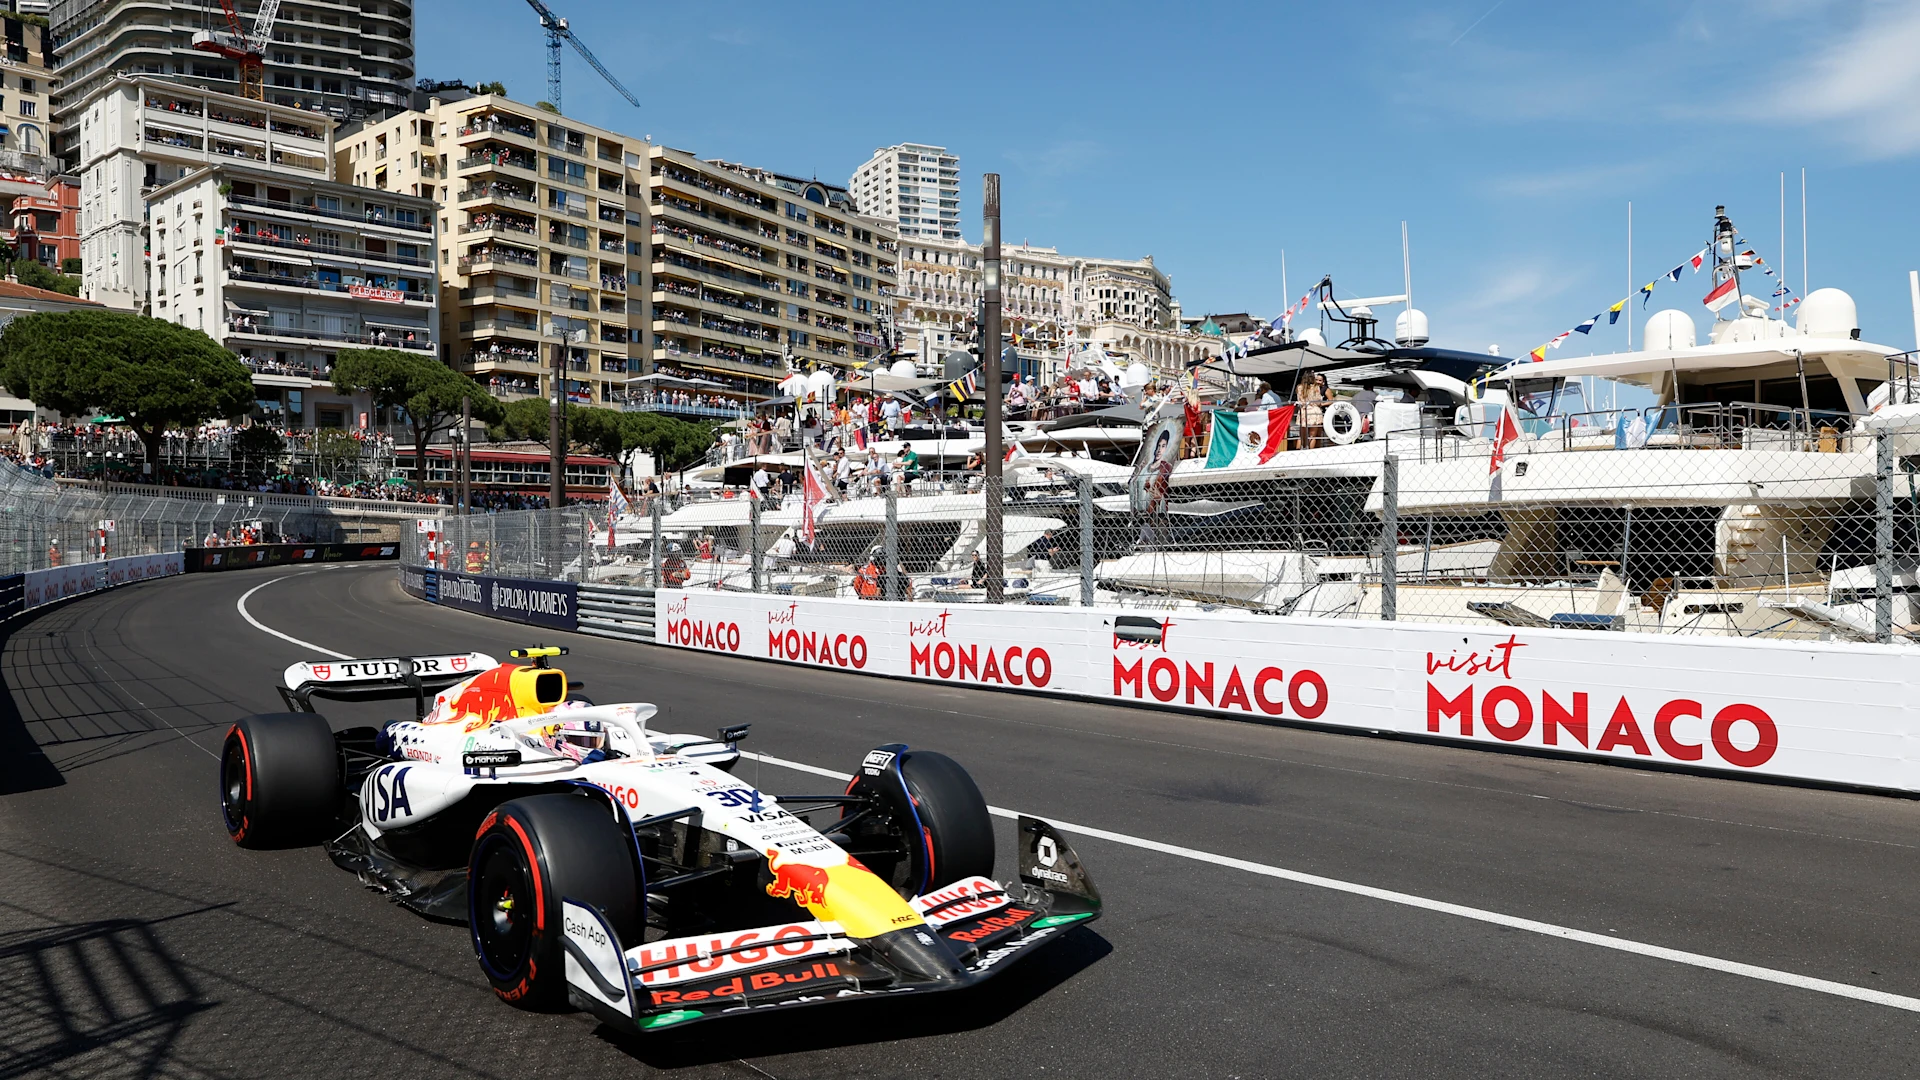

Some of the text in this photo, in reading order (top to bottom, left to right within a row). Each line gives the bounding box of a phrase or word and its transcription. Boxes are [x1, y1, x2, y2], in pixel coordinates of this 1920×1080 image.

[359, 287, 397, 299] LECLERC
[443, 580, 460, 599] EXPLORA
[500, 587, 568, 617] EXPLORA JOURNEYS
[667, 594, 688, 615] visit
[768, 601, 798, 626] visit
[909, 608, 951, 638] visit
[667, 618, 740, 652] MONACO
[768, 629, 868, 669] MONACO
[341, 659, 442, 677] TUDOR
[910, 641, 1052, 688] MONACO
[1426, 633, 1529, 679] visit
[1113, 654, 1329, 720] MONACO
[1427, 680, 1779, 768] MONACO
[406, 748, 433, 764] HONDA
[866, 753, 890, 765] NEFT
[364, 765, 413, 823] VISA
[692, 783, 744, 793] TUDOR
[706, 789, 763, 808] 30
[737, 811, 792, 823] VISA
[771, 828, 815, 838] dynatrace
[790, 843, 832, 855] Mobil
[1032, 866, 1068, 883] dynatrace
[921, 880, 1004, 921] HUGO
[565, 917, 606, 947] Cash App
[949, 918, 997, 943] Red
[993, 908, 1035, 932] Bull
[640, 926, 814, 983] HUGO
[650, 977, 745, 1006] Red
[750, 963, 841, 991] Bull
